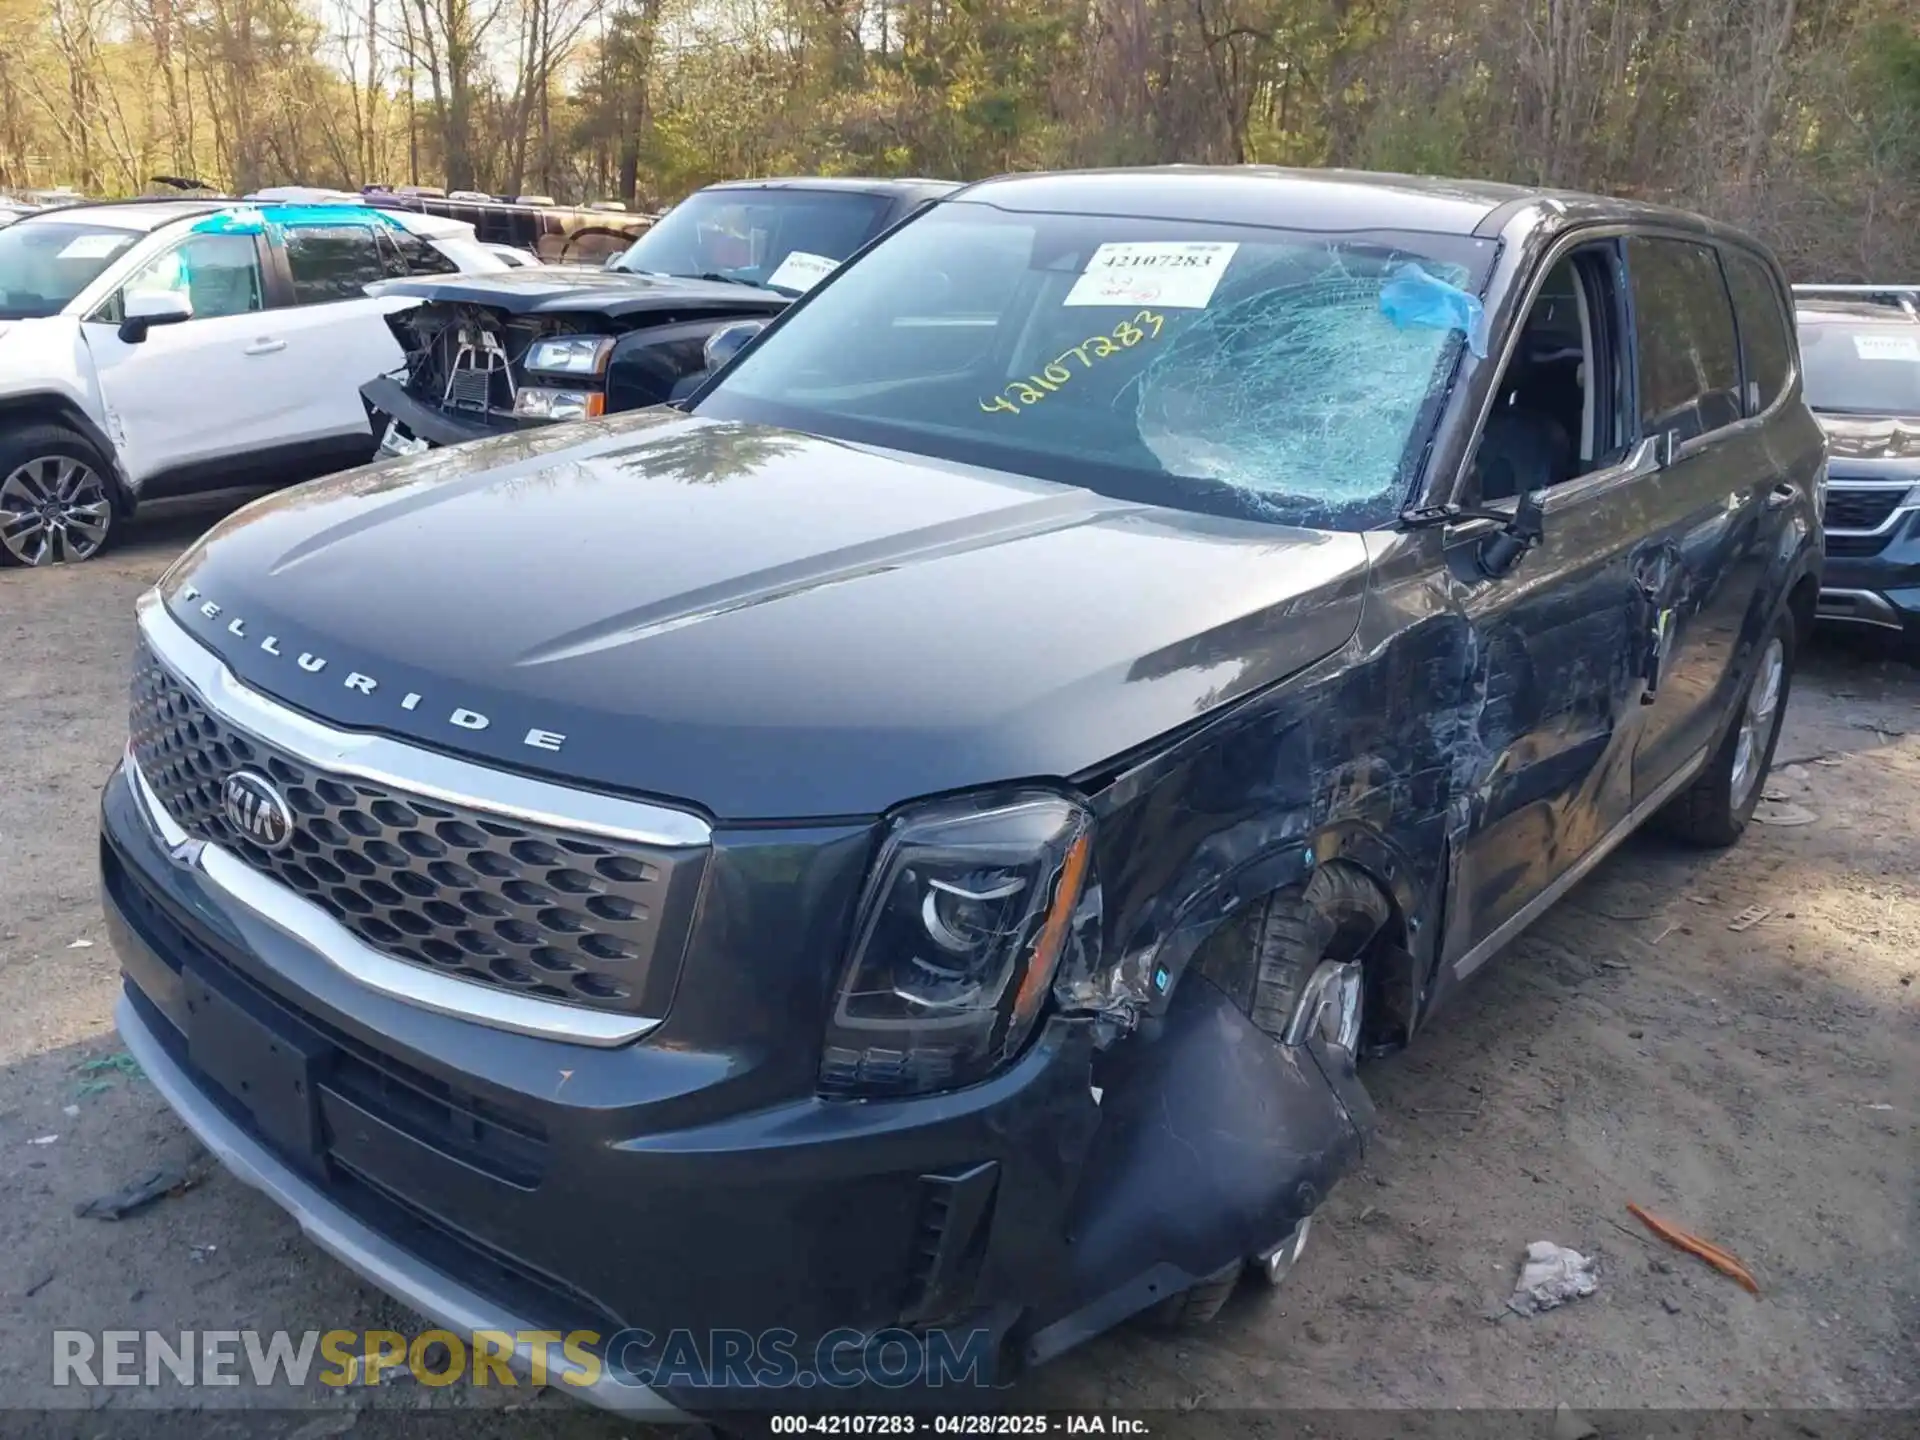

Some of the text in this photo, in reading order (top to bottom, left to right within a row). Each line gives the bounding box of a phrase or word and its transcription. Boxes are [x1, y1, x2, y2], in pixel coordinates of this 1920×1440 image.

[1102, 254, 1213, 268] 42107283
[979, 310, 1164, 414] 42107283
[183, 584, 568, 752] TELLURIDE
[225, 782, 278, 842] KIA
